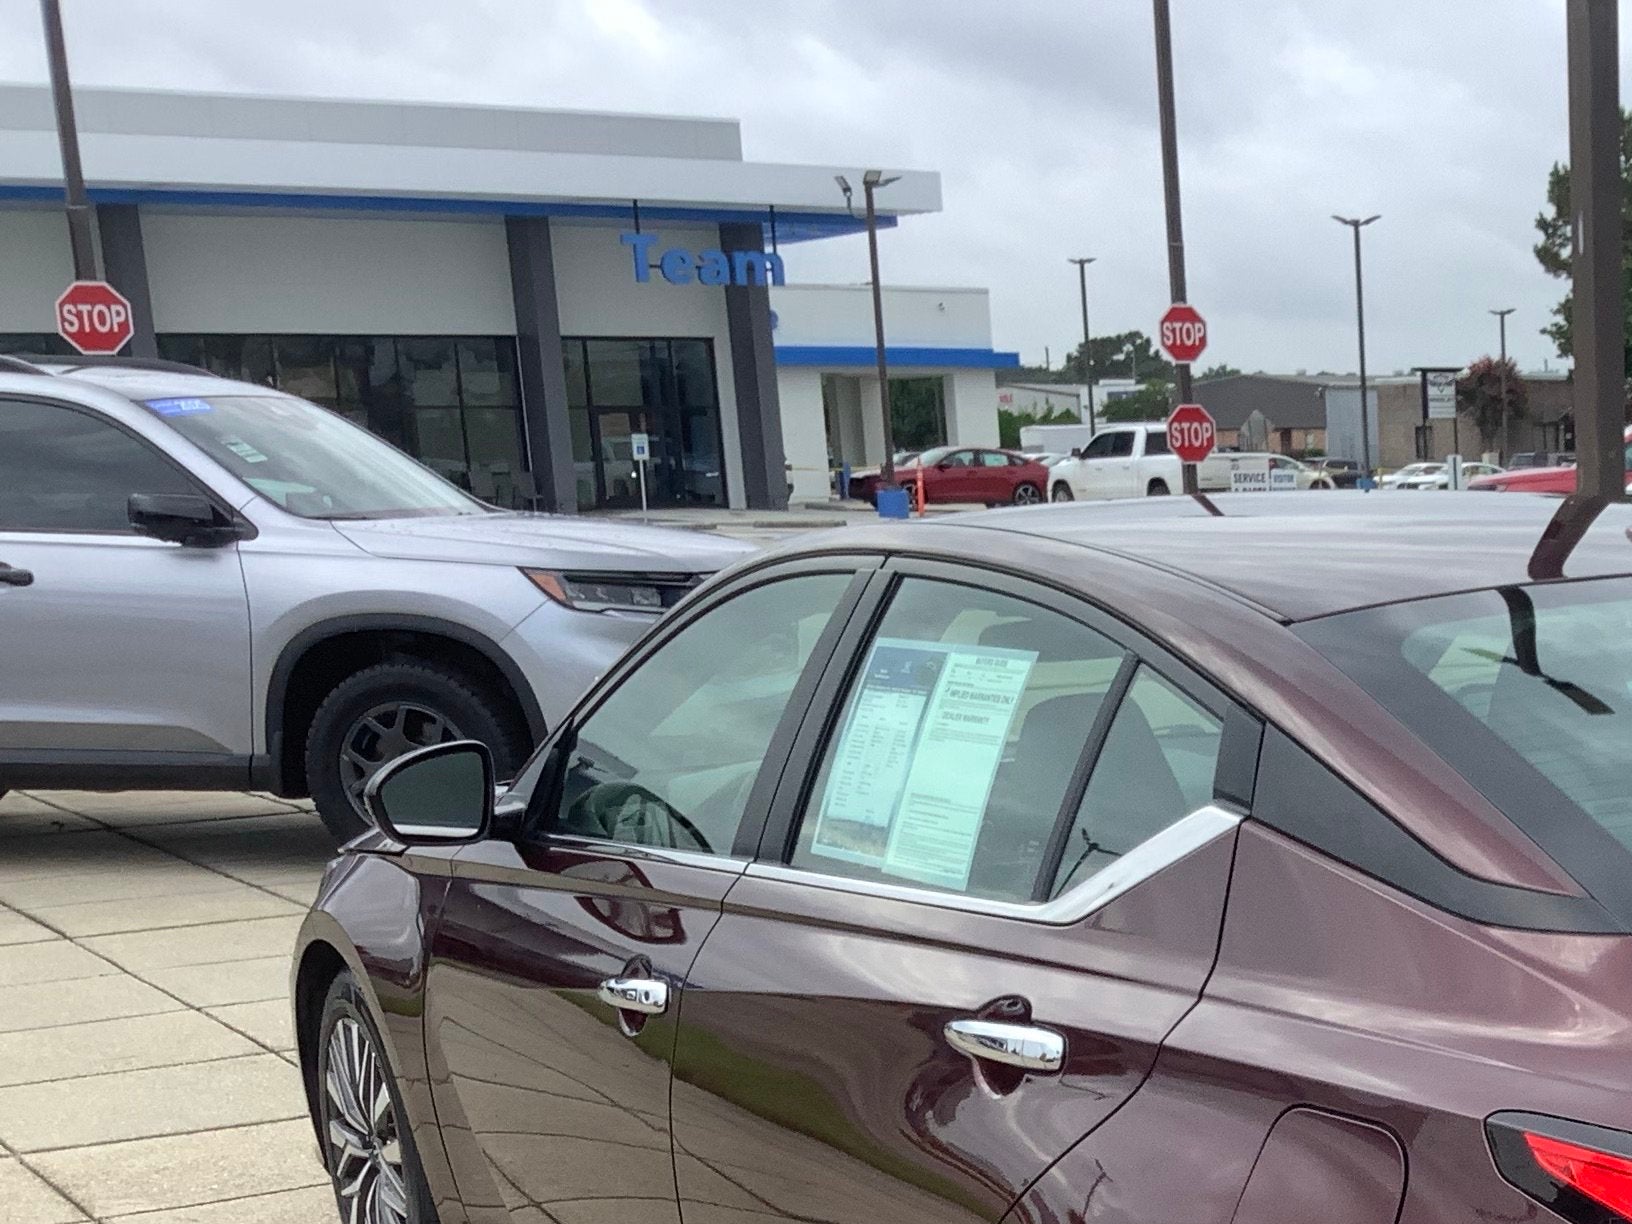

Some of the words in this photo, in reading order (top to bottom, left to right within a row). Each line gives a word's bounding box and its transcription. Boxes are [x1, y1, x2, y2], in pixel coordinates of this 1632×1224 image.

[620, 231, 786, 287] Team
[62, 303, 127, 334] STOP
[1162, 321, 1205, 347] STOP
[1171, 421, 1213, 448] STOP
[1233, 472, 1266, 484] SERVICE
